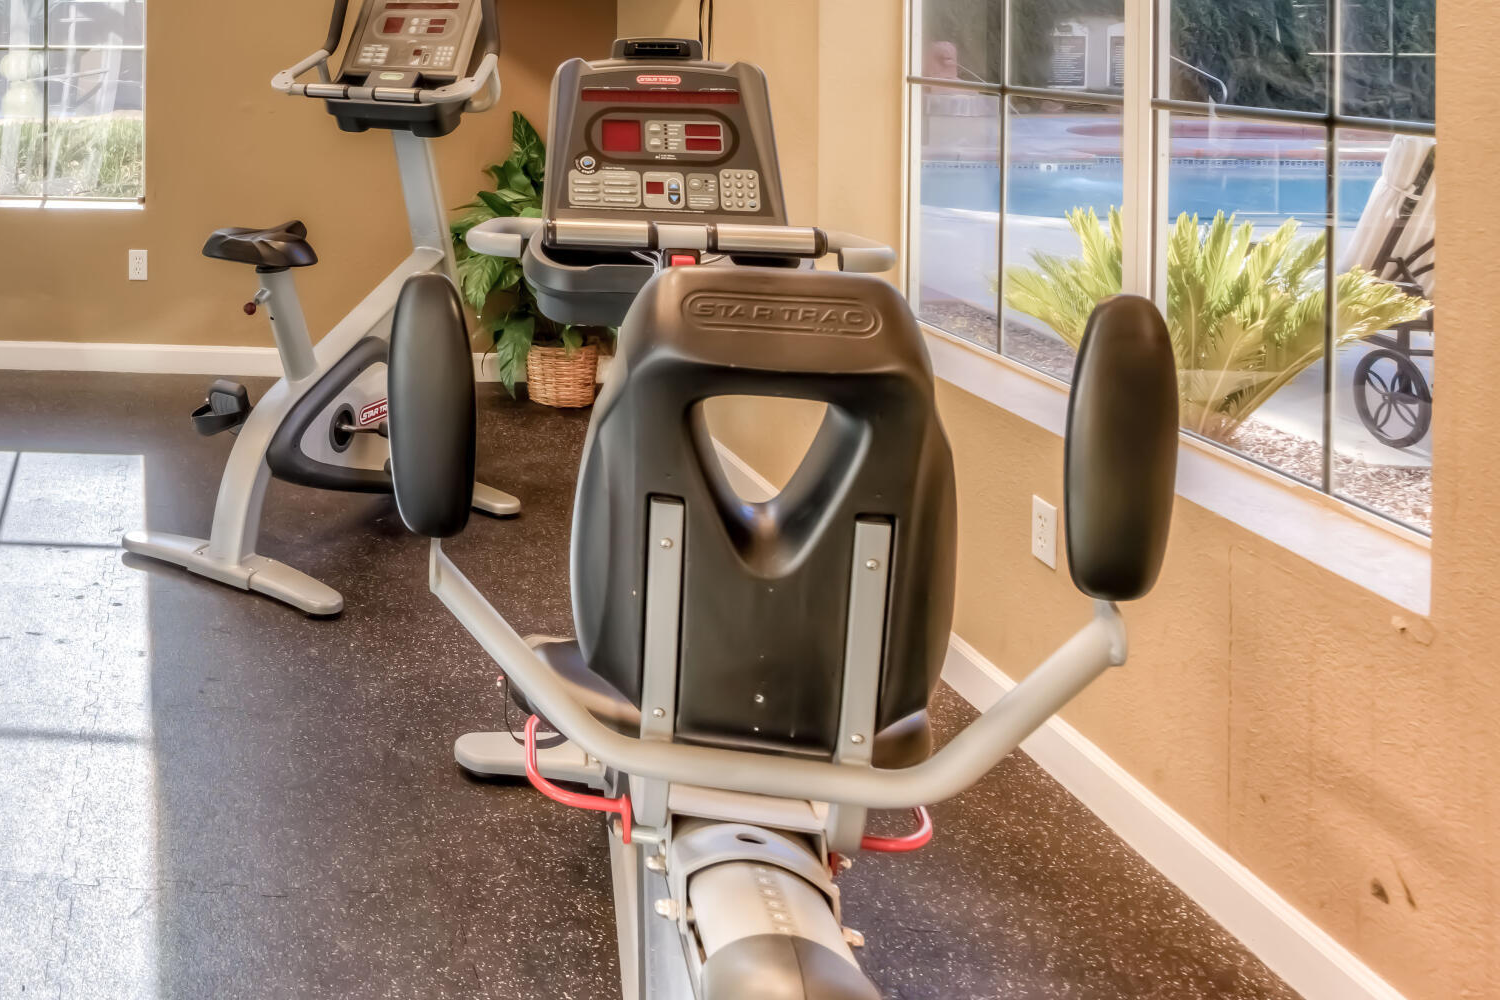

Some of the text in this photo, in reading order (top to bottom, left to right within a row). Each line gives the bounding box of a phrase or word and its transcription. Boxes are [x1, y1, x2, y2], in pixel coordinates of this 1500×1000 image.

[694, 303, 866, 325] STAR TRAC
[362, 407, 379, 419] STAR
